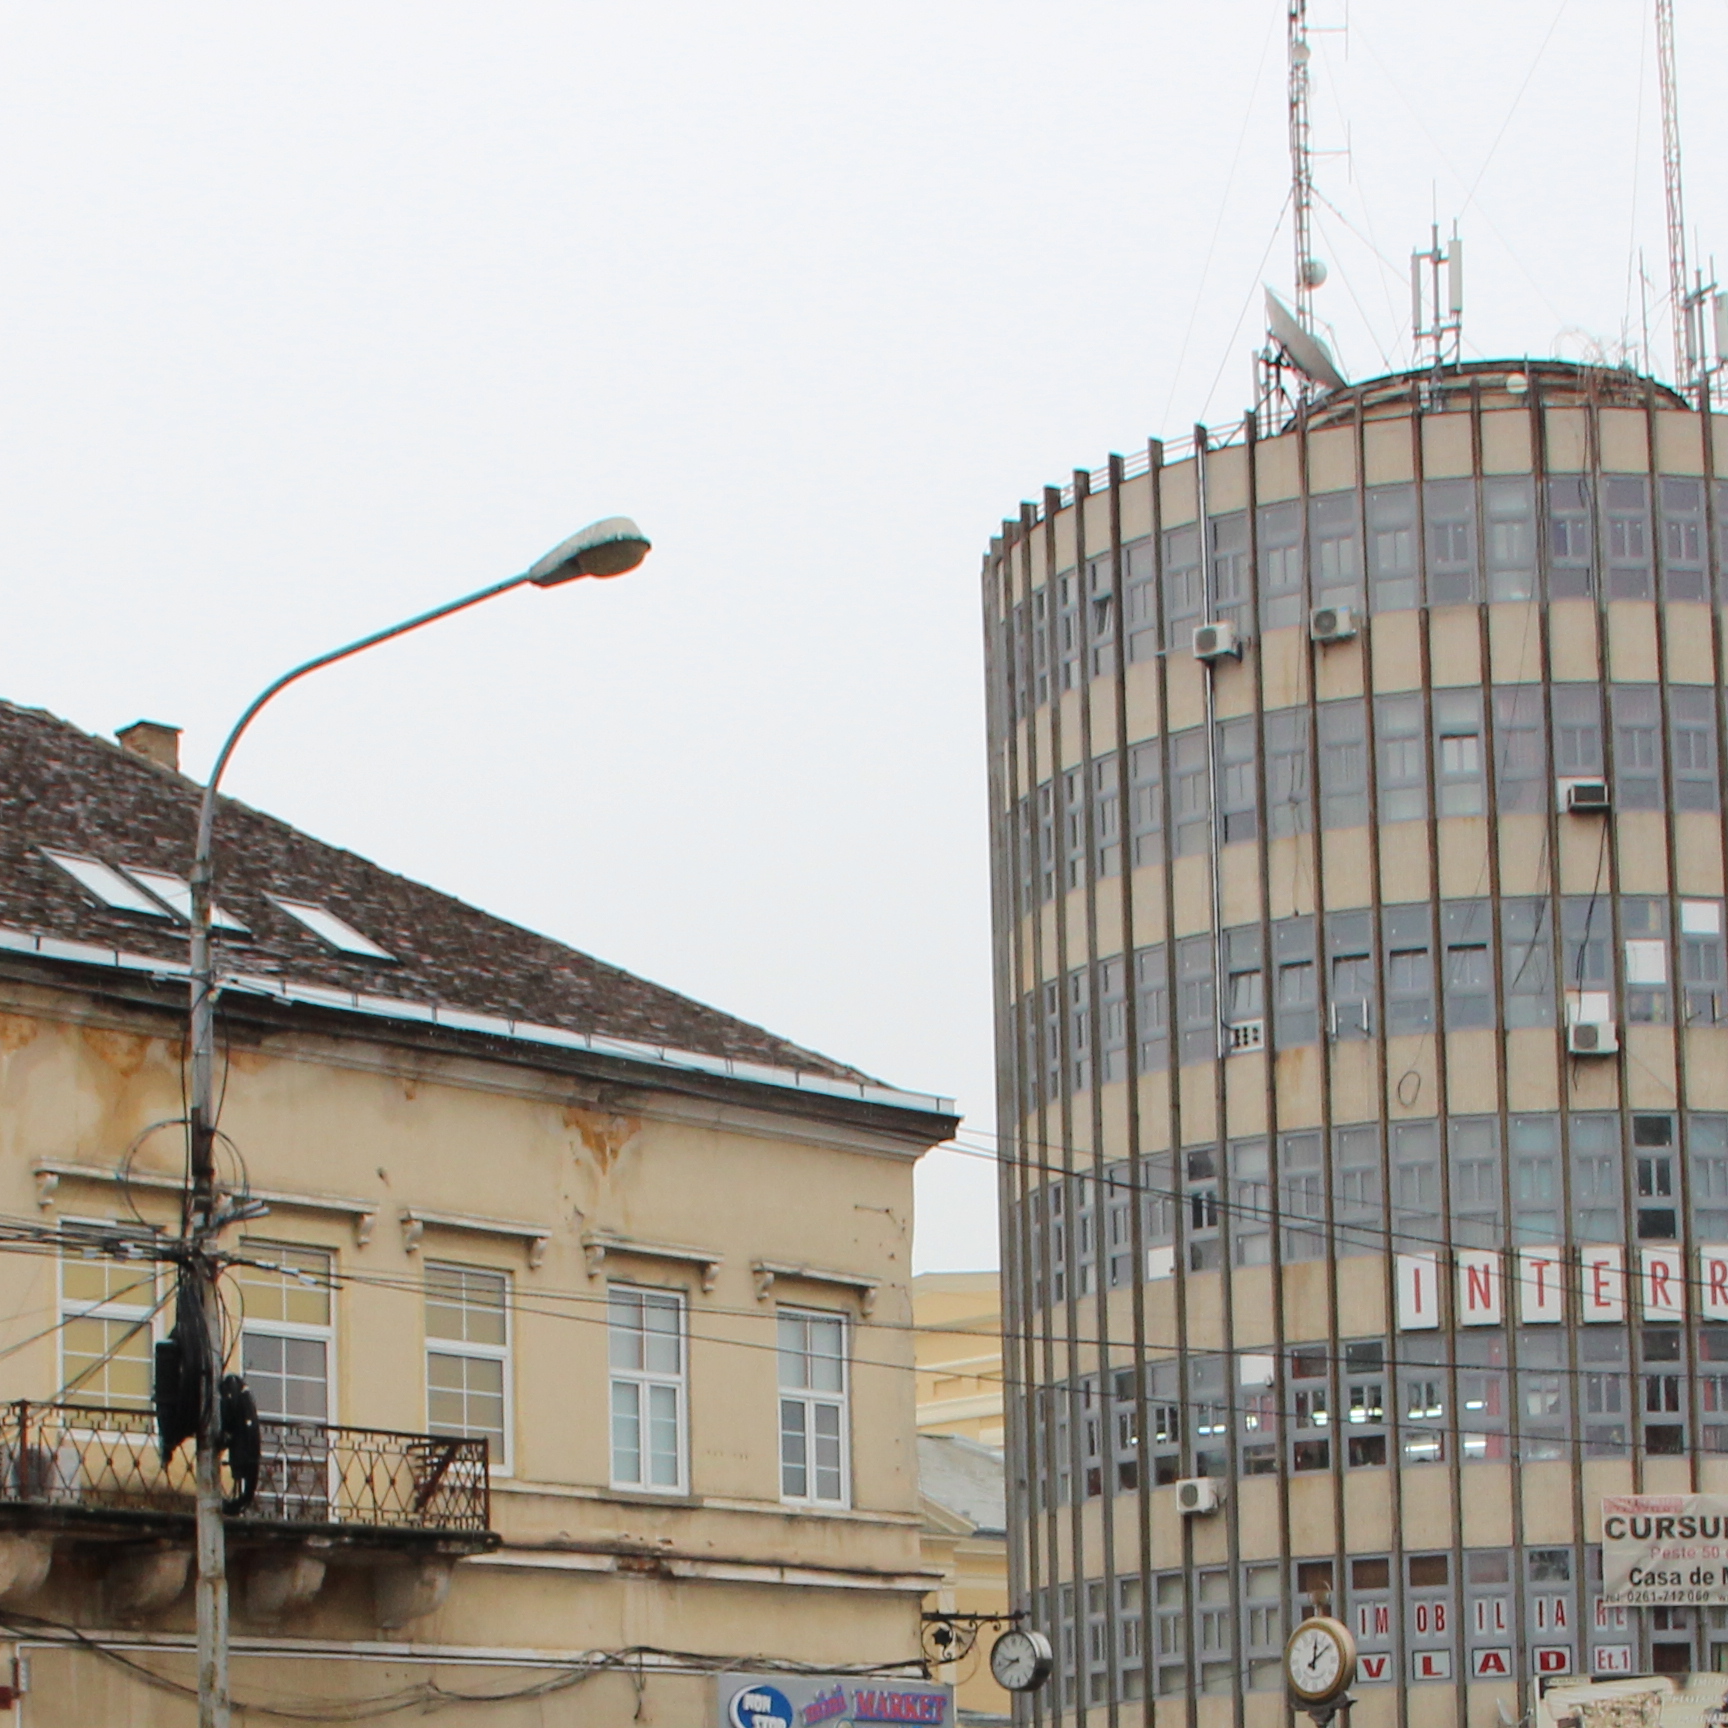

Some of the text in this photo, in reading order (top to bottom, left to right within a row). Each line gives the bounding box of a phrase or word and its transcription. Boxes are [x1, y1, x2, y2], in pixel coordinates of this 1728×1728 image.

[1650, 1546, 1697, 1560] Peste
[1629, 1567, 1682, 1587] Casa
[1689, 1566, 1715, 1586] de
[1362, 1649, 1567, 1678] VLAD
[852, 1690, 949, 1724] MARKET
